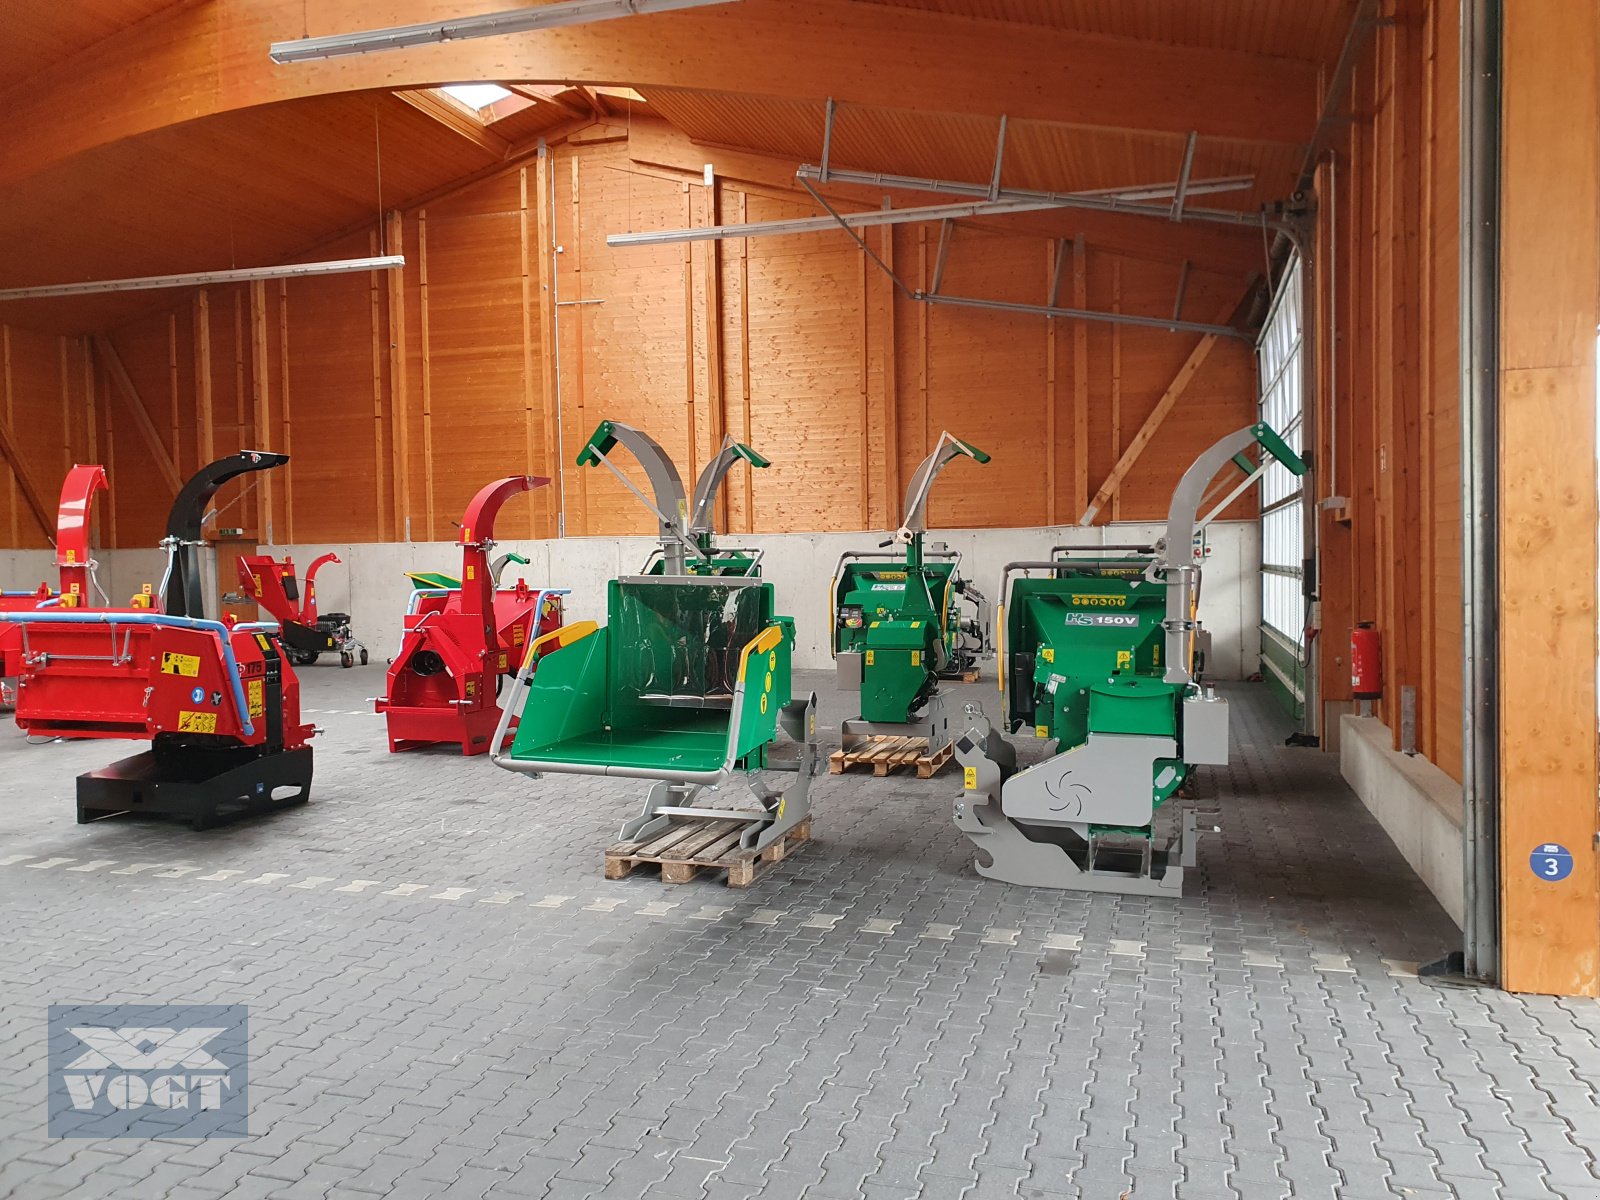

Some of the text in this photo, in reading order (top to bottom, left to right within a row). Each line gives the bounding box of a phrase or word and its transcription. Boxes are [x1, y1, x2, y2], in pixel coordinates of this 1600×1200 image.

[1065, 612, 1136, 626] HS 150V
[247, 662, 262, 674] 175
[1544, 858, 1558, 876] 3
